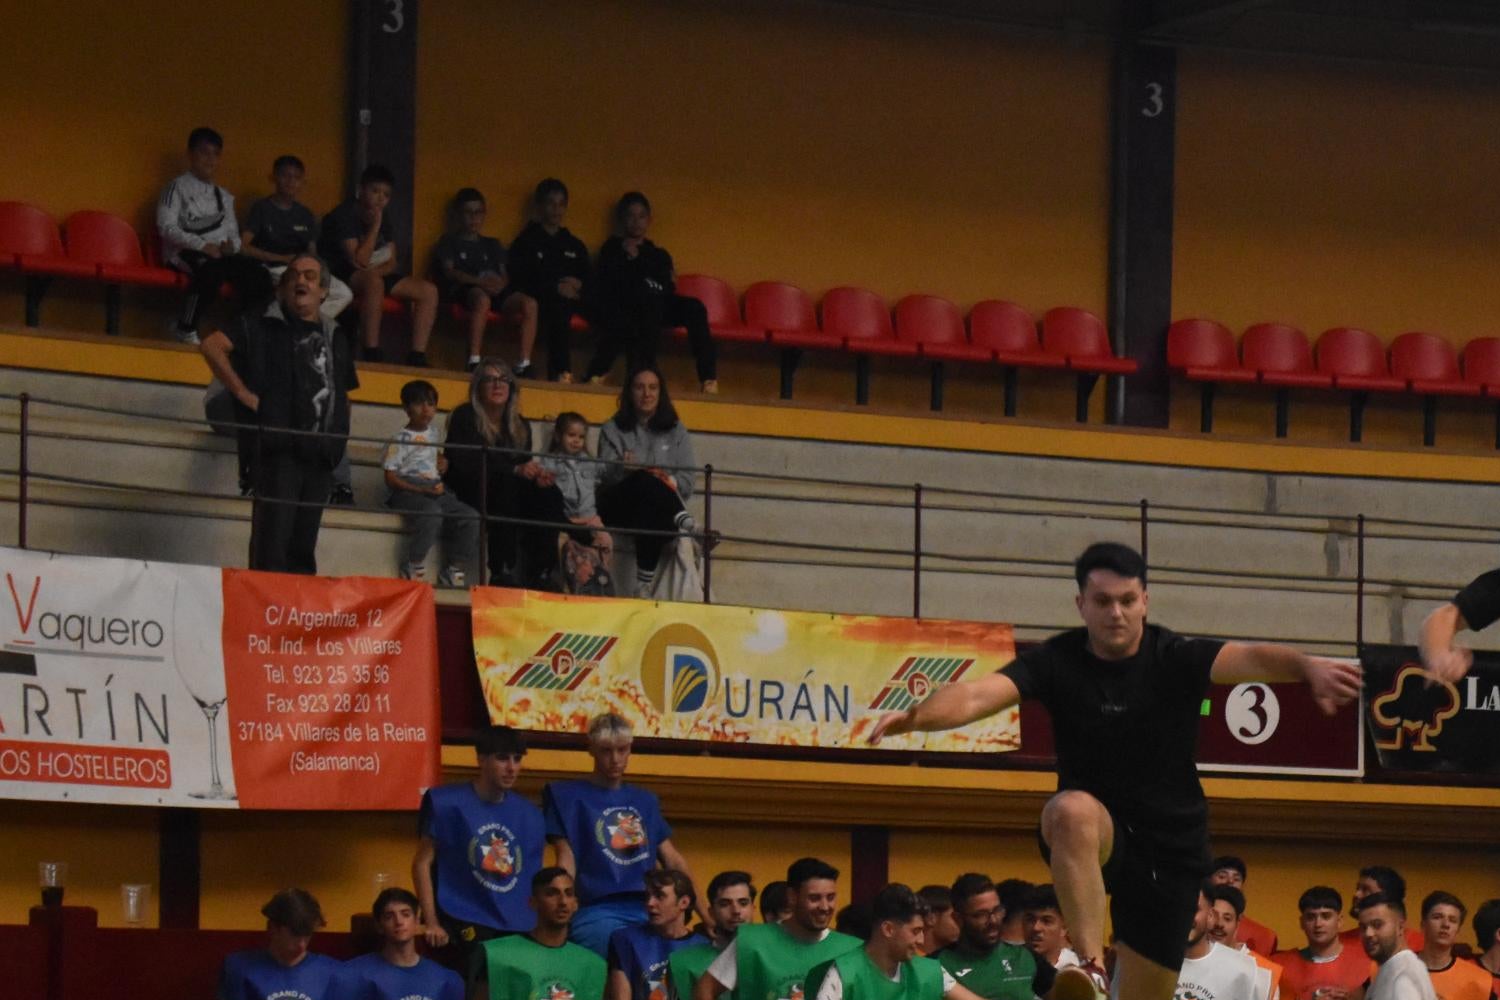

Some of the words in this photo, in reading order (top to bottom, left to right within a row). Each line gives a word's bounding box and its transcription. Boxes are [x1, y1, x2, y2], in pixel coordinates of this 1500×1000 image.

[382, 0, 405, 33] 3
[1142, 82, 1163, 117] 3
[7, 573, 164, 650] Vaquero
[265, 605, 284, 625] C/
[288, 607, 360, 631] Argentina,
[366, 608, 384, 628] 12
[248, 634, 275, 655] Pol.
[280, 636, 308, 655] Ind.
[316, 637, 345, 656] Los
[346, 637, 402, 655] Villares
[263, 664, 289, 684] Tel.
[293, 665, 323, 685] 923
[327, 665, 348, 685] 25
[353, 665, 371, 684] 35
[373, 664, 390, 684] 96
[664, 645, 849, 723] DURÁN
[0, 673, 170, 744] RTÍN
[266, 693, 294, 713] Fax
[298, 693, 329, 713] 923
[334, 693, 351, 713] 28
[354, 694, 371, 713] 20
[375, 694, 391, 713] 11
[1239, 685, 1268, 738] 3
[238, 721, 284, 742] 37184
[287, 722, 341, 742] Villares
[344, 722, 362, 742] de
[366, 723, 380, 742] la
[383, 722, 427, 742] Reina
[37, 751, 168, 784] HOSTELEROS
[290, 751, 380, 776] (Salamanca)
